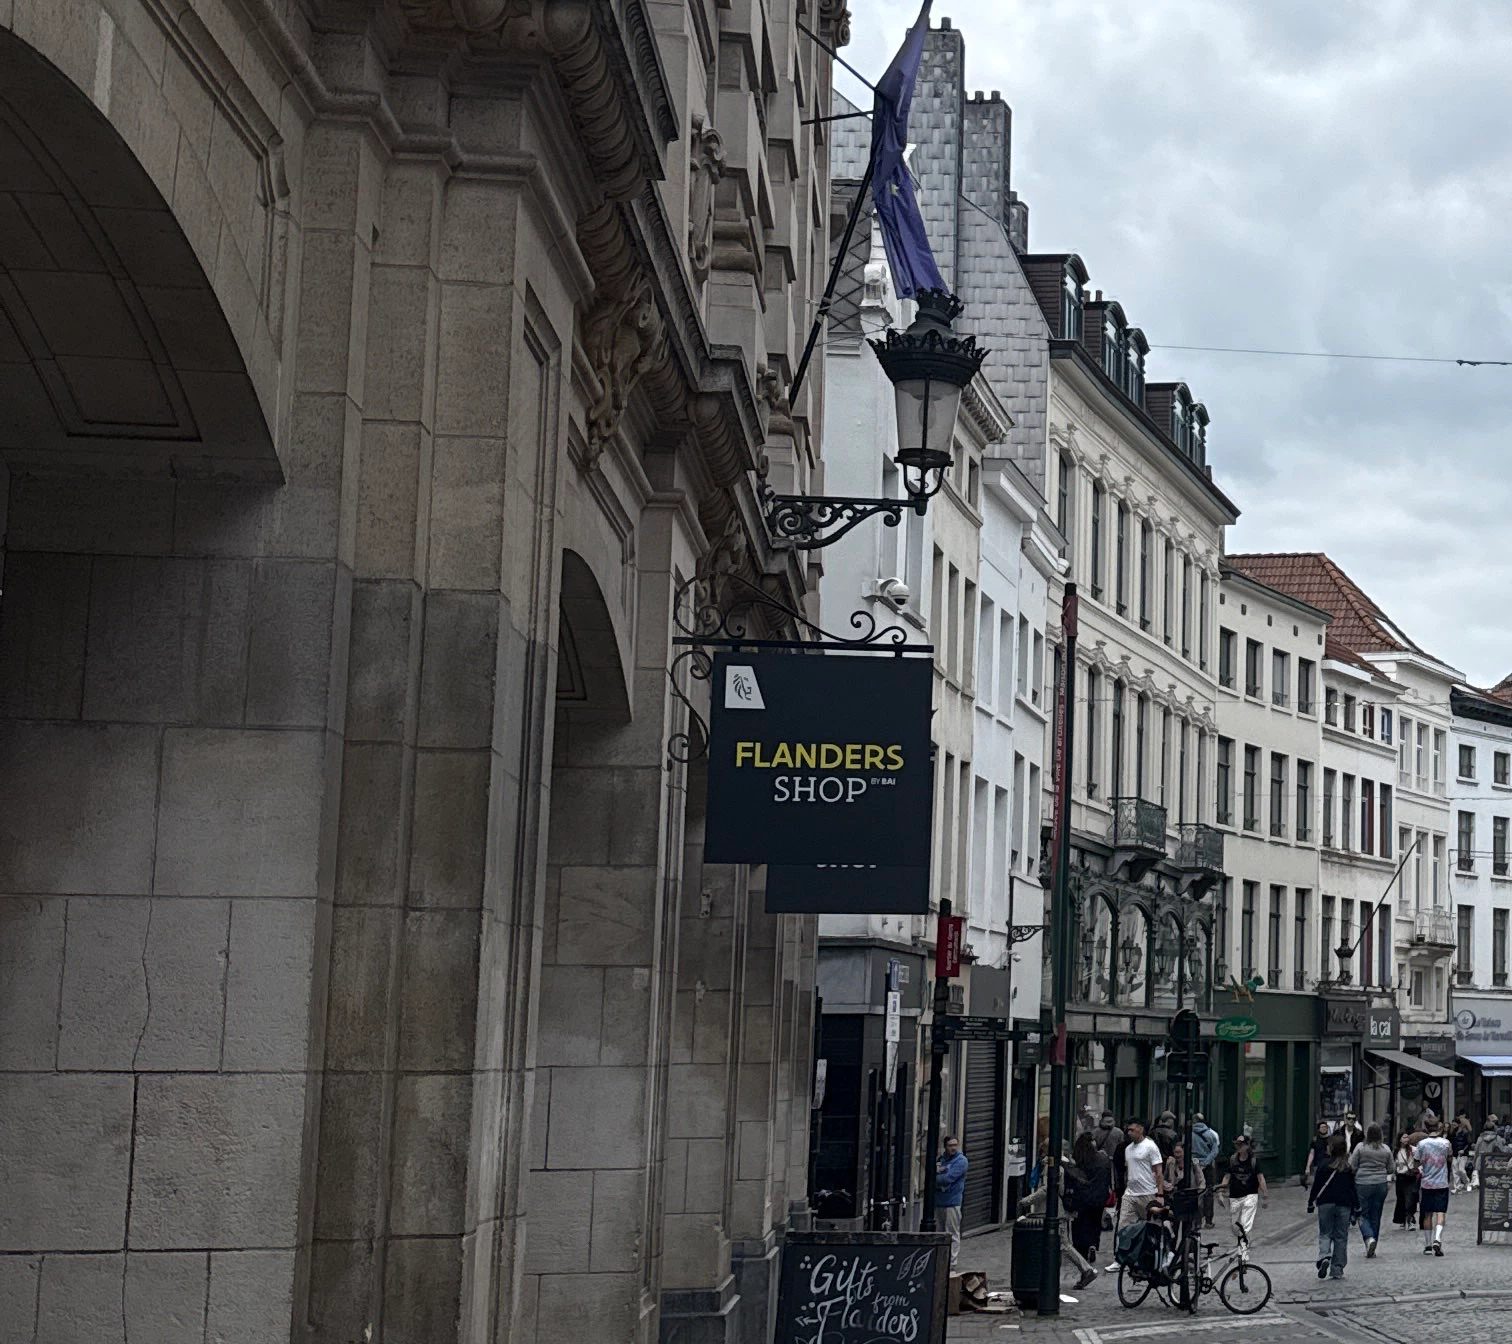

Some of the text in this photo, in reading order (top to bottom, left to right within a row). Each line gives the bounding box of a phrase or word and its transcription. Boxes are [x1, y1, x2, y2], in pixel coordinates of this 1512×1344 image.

[736, 741, 904, 770] FLANDERS
[774, 776, 867, 803] SHOP
[870, 777, 881, 785] BY
[1370, 1015, 1378, 1035] la
[810, 1254, 878, 1304] Gifts
[871, 1292, 909, 1314] from
